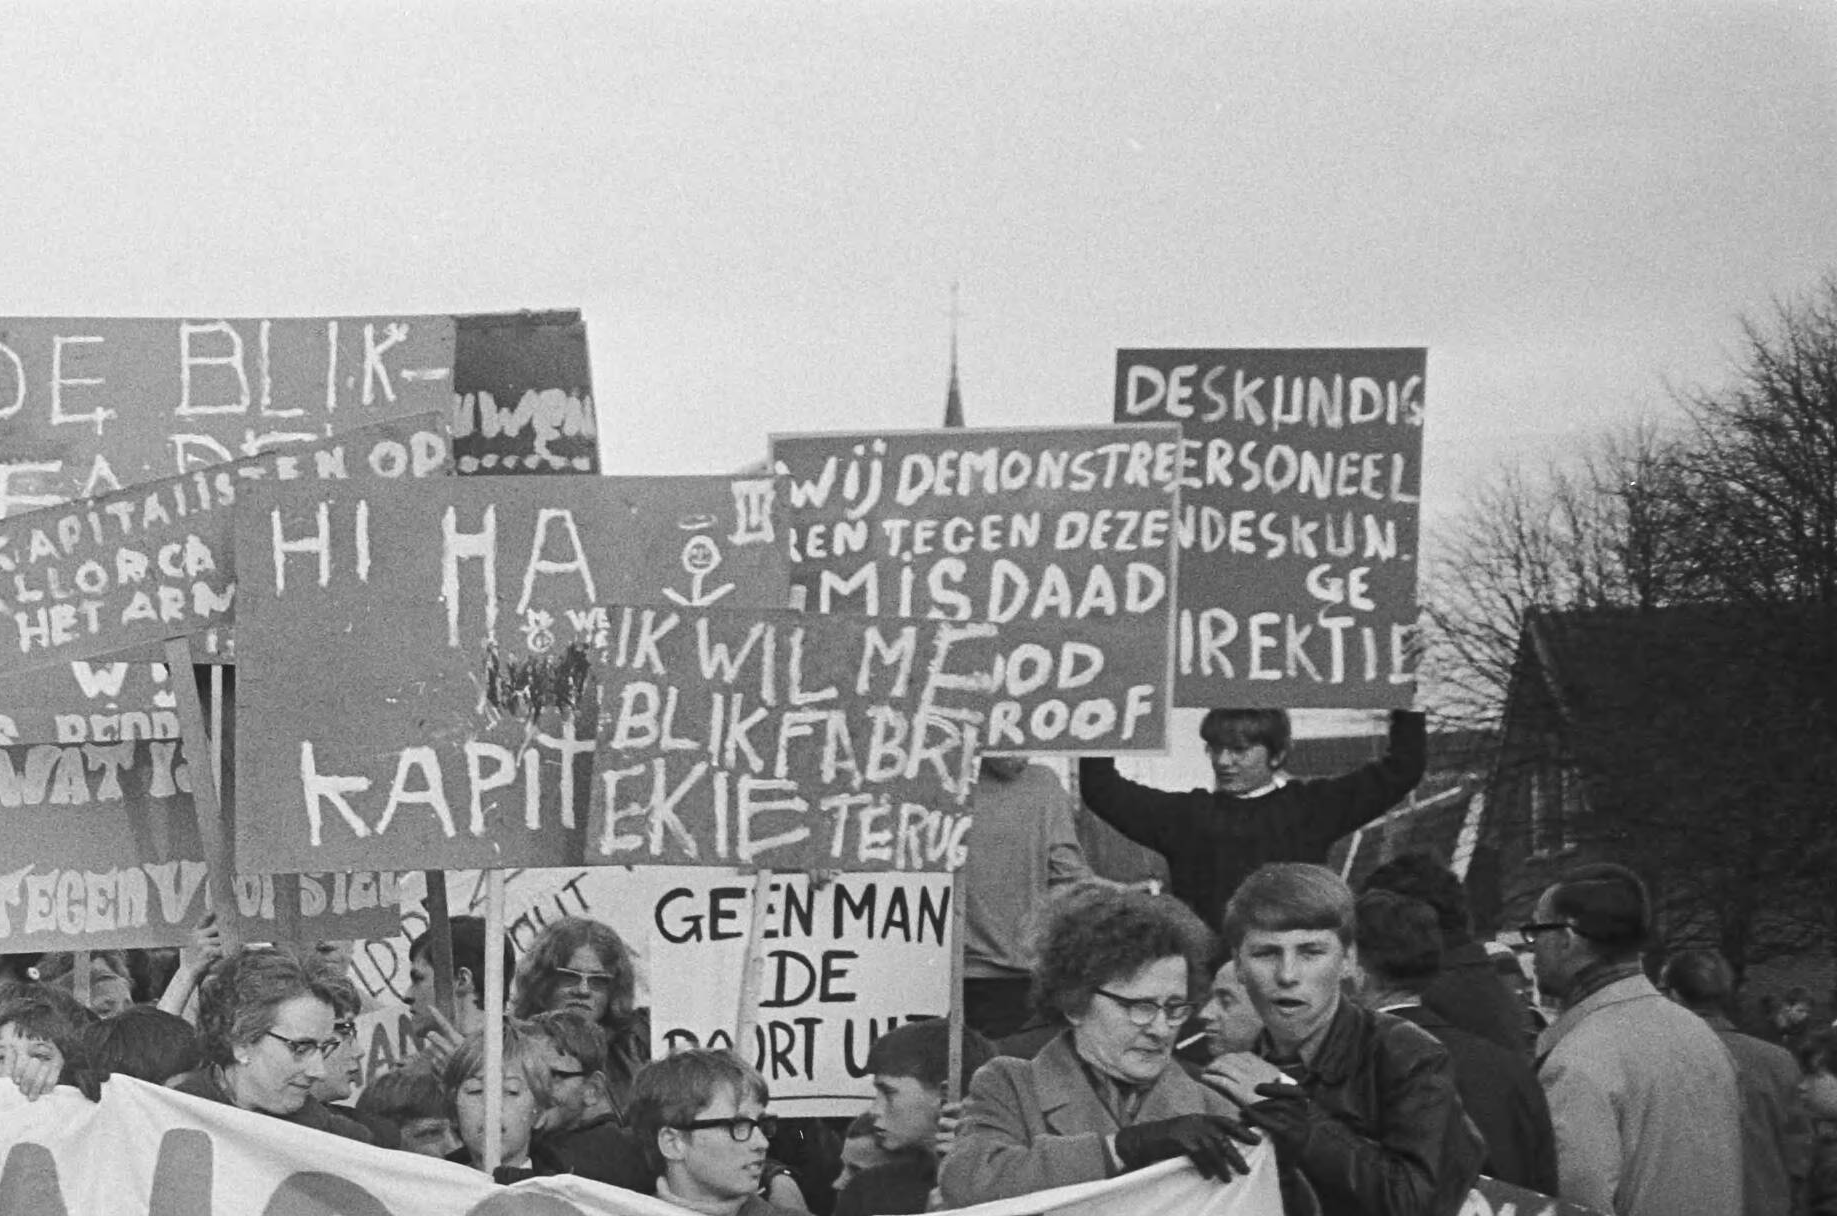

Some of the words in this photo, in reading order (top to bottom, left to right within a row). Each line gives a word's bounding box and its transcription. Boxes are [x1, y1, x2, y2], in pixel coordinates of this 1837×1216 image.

[882, 512, 1041, 559] TEGEN
[1054, 508, 1170, 552] DEZE
[270, 499, 371, 598] HI
[441, 503, 597, 646] HA
[1306, 563, 1376, 613] GE
[615, 606, 681, 675] IK
[695, 616, 840, 706] WIL
[300, 710, 598, 846] KAPIT
[832, 882, 952, 947] MAN
[759, 949, 859, 1008] DE
